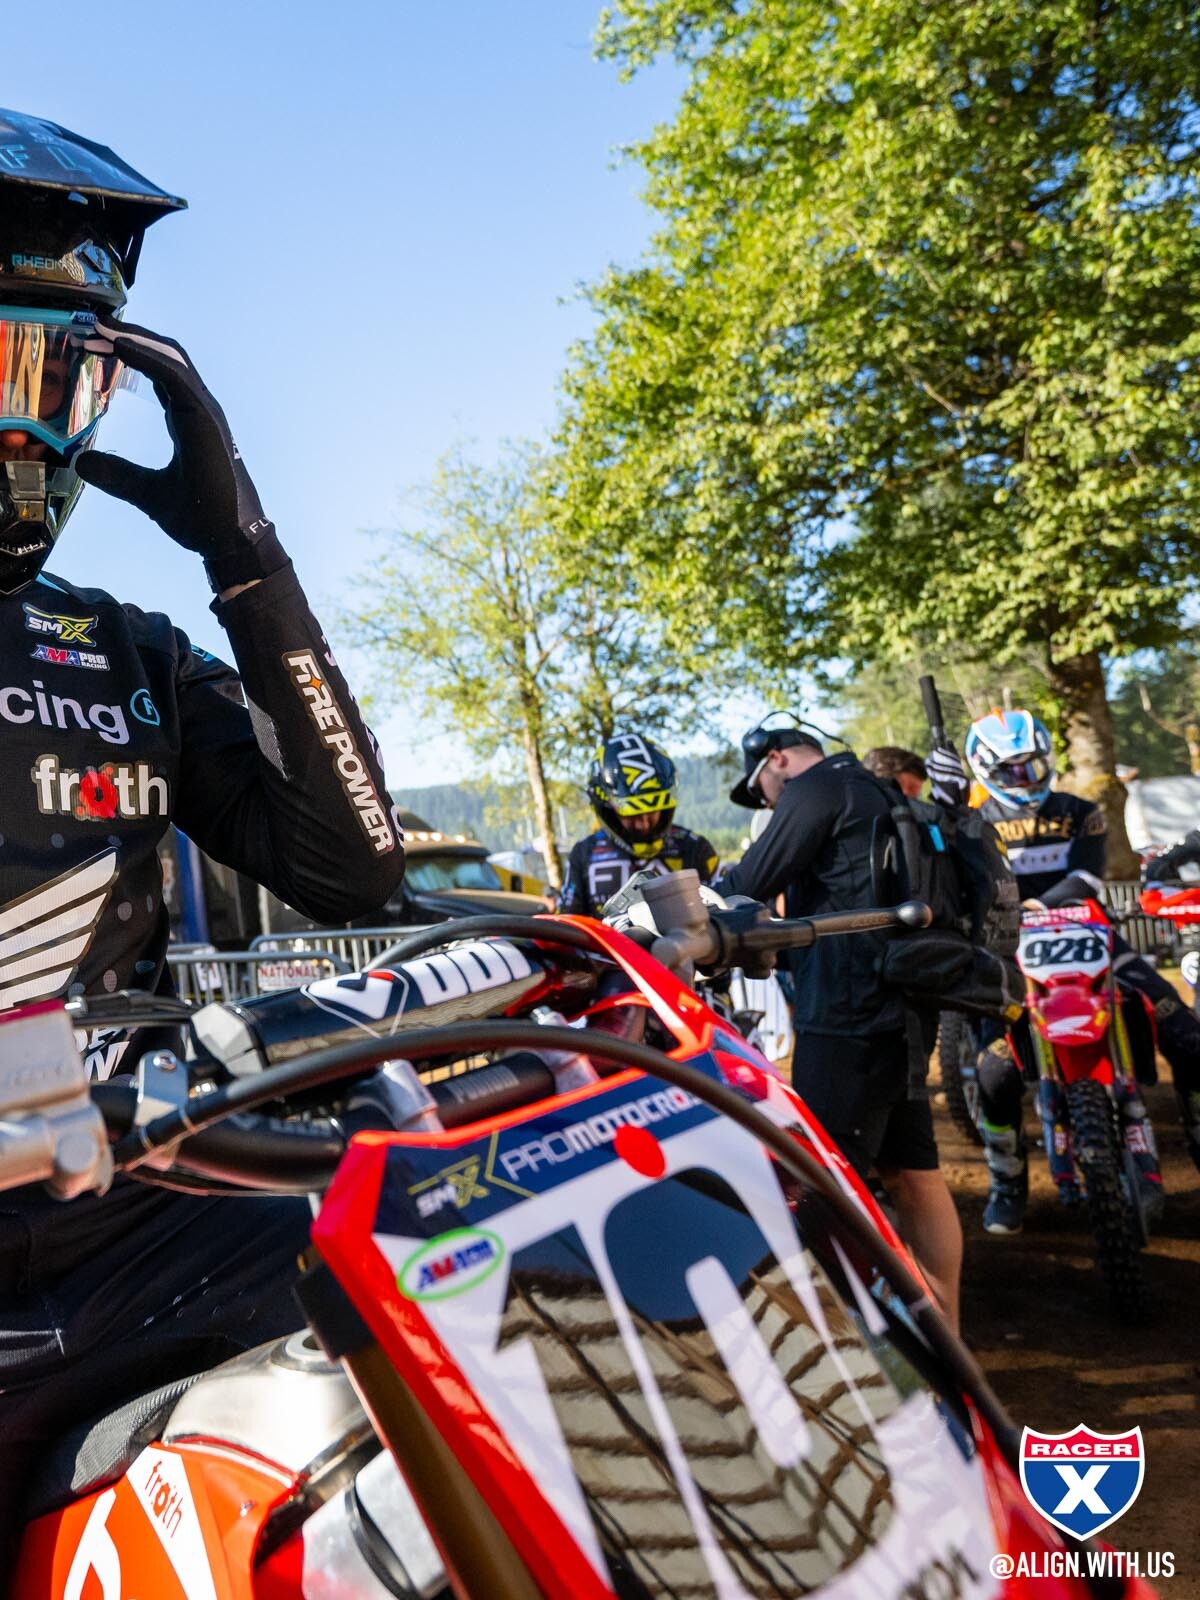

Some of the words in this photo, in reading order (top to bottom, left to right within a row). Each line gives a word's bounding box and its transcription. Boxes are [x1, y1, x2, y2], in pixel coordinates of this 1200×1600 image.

[28, 616, 93, 644] SMX
[30, 645, 81, 666] AMA
[79, 652, 107, 665] PRO
[81, 661, 108, 670] RACING
[1024, 936, 1105, 968] 928
[260, 965, 318, 978] NATIONAL
